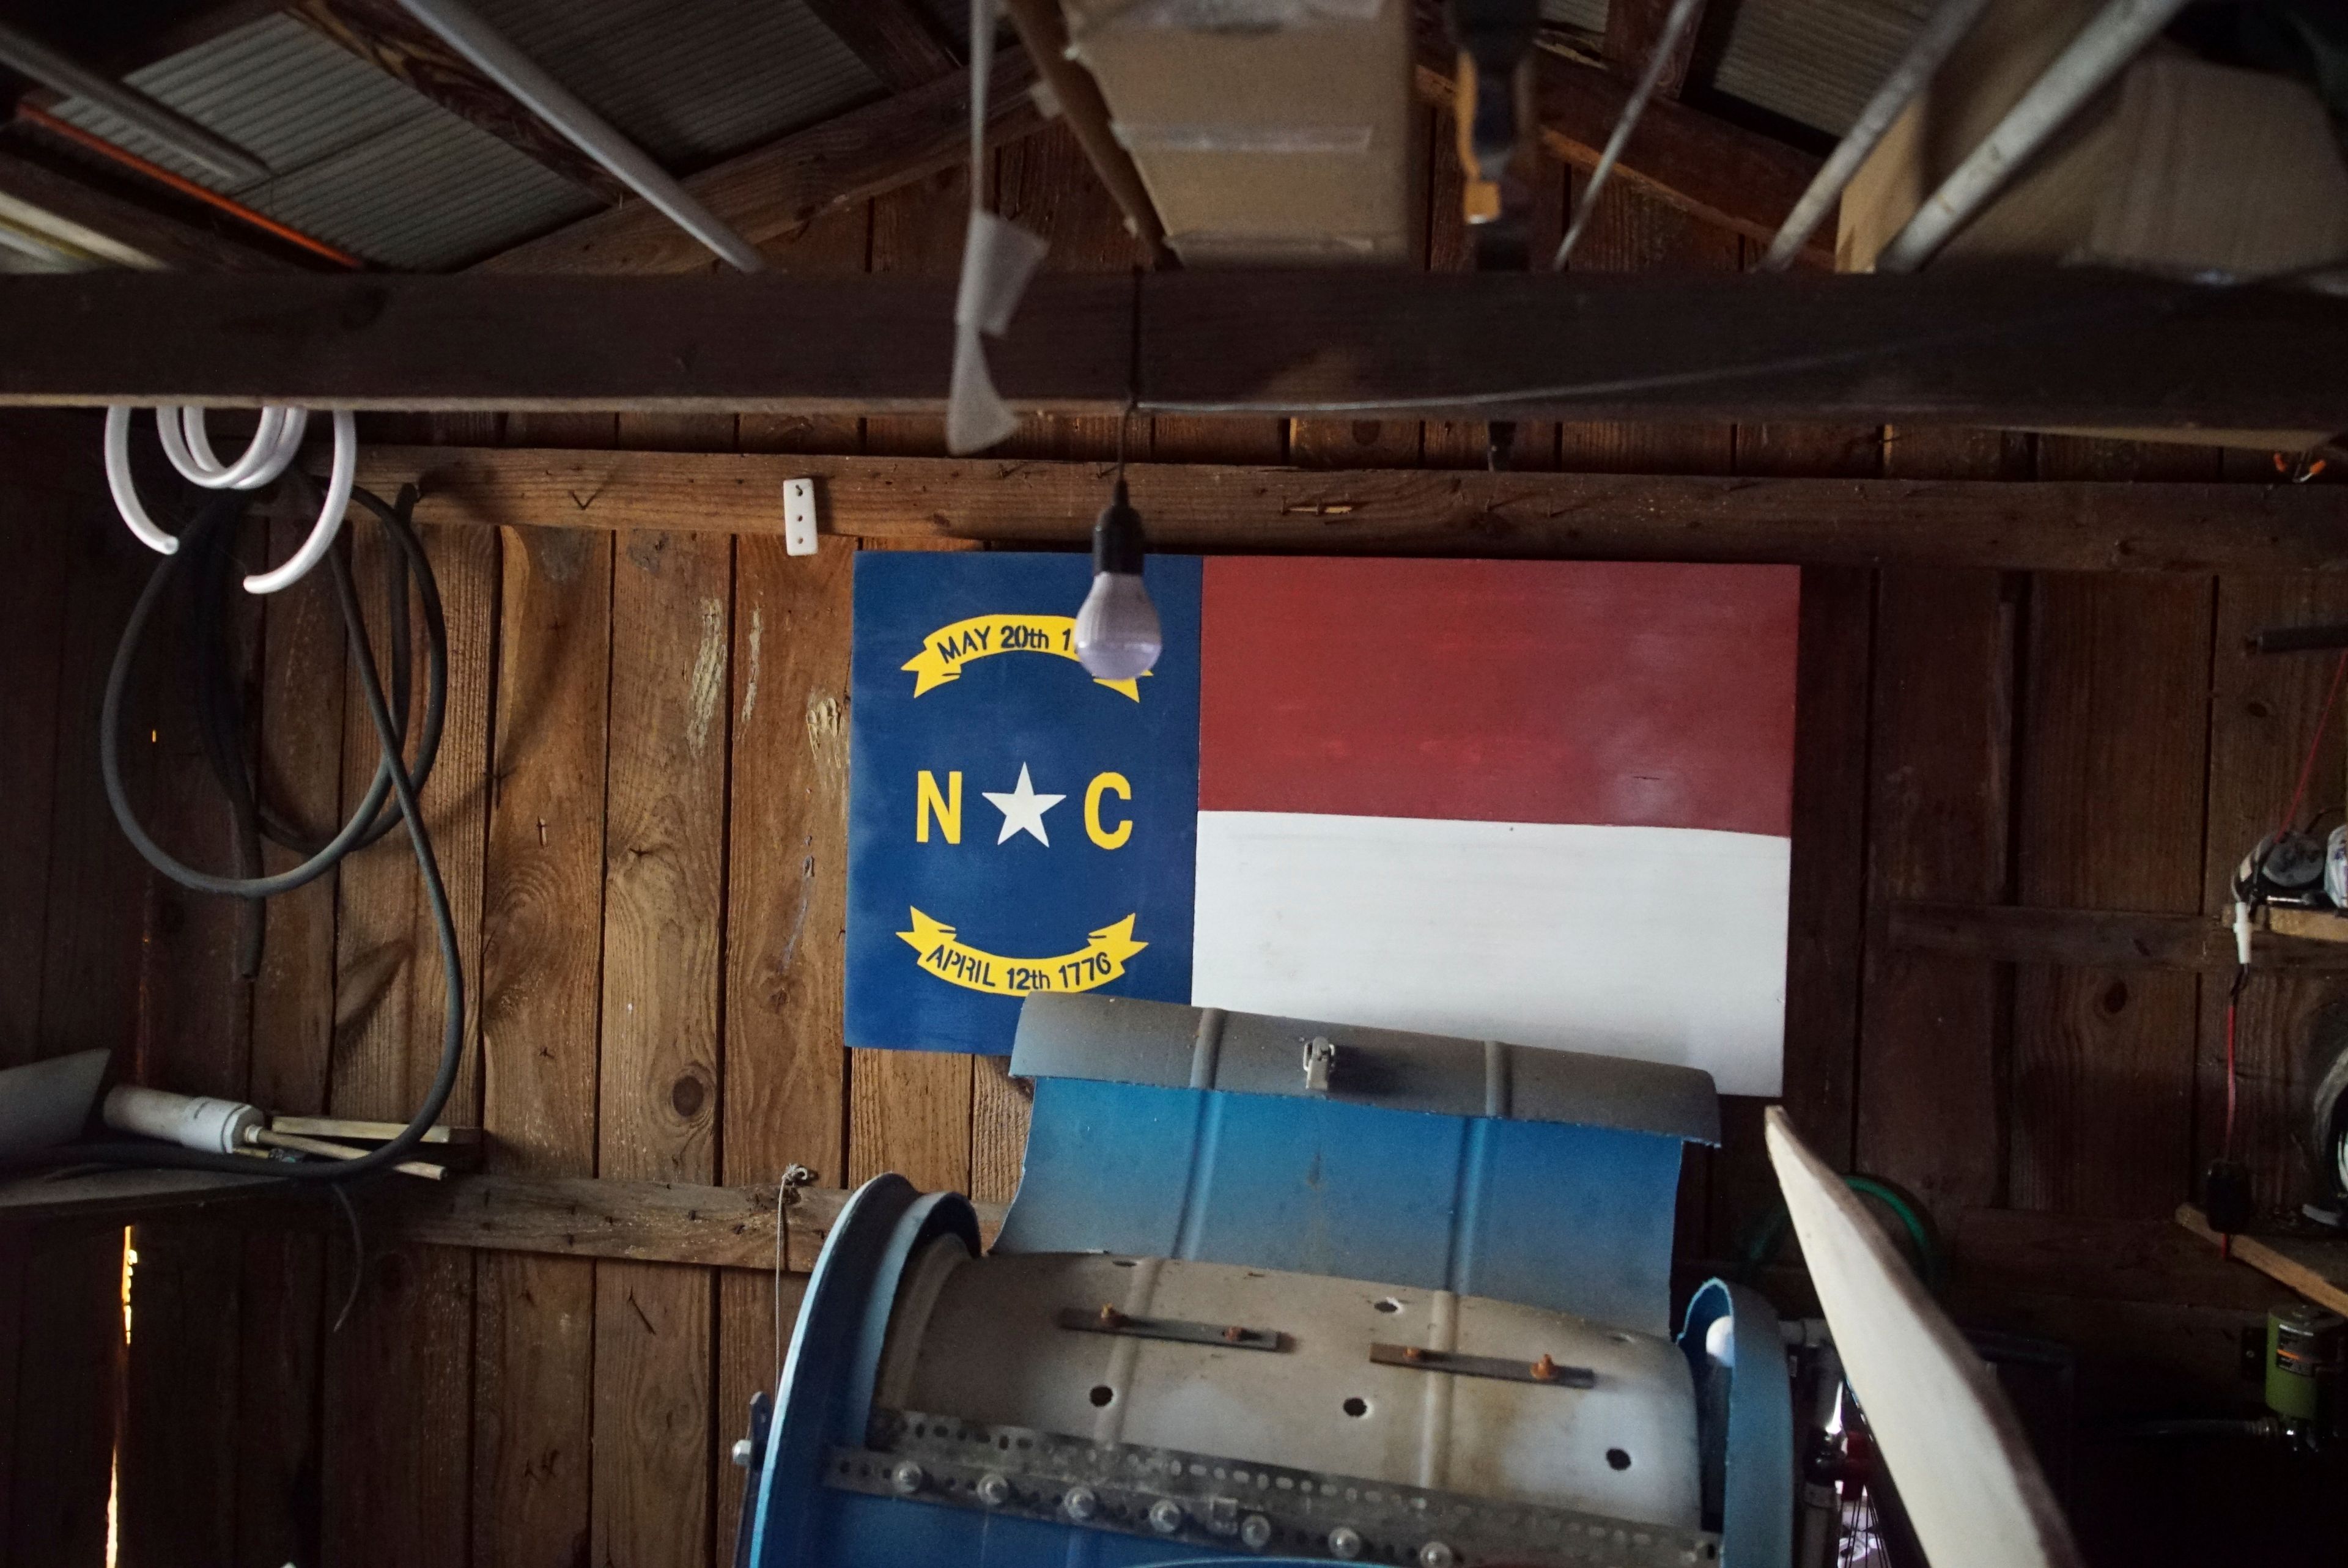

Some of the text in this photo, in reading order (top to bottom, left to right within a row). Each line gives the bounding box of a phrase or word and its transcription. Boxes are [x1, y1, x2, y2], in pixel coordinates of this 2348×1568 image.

[937, 625, 991, 664] MAY
[1000, 625, 1049, 649] 20th
[917, 770, 1132, 850] N C
[926, 944, 1111, 990] APRIL 12th 1776
